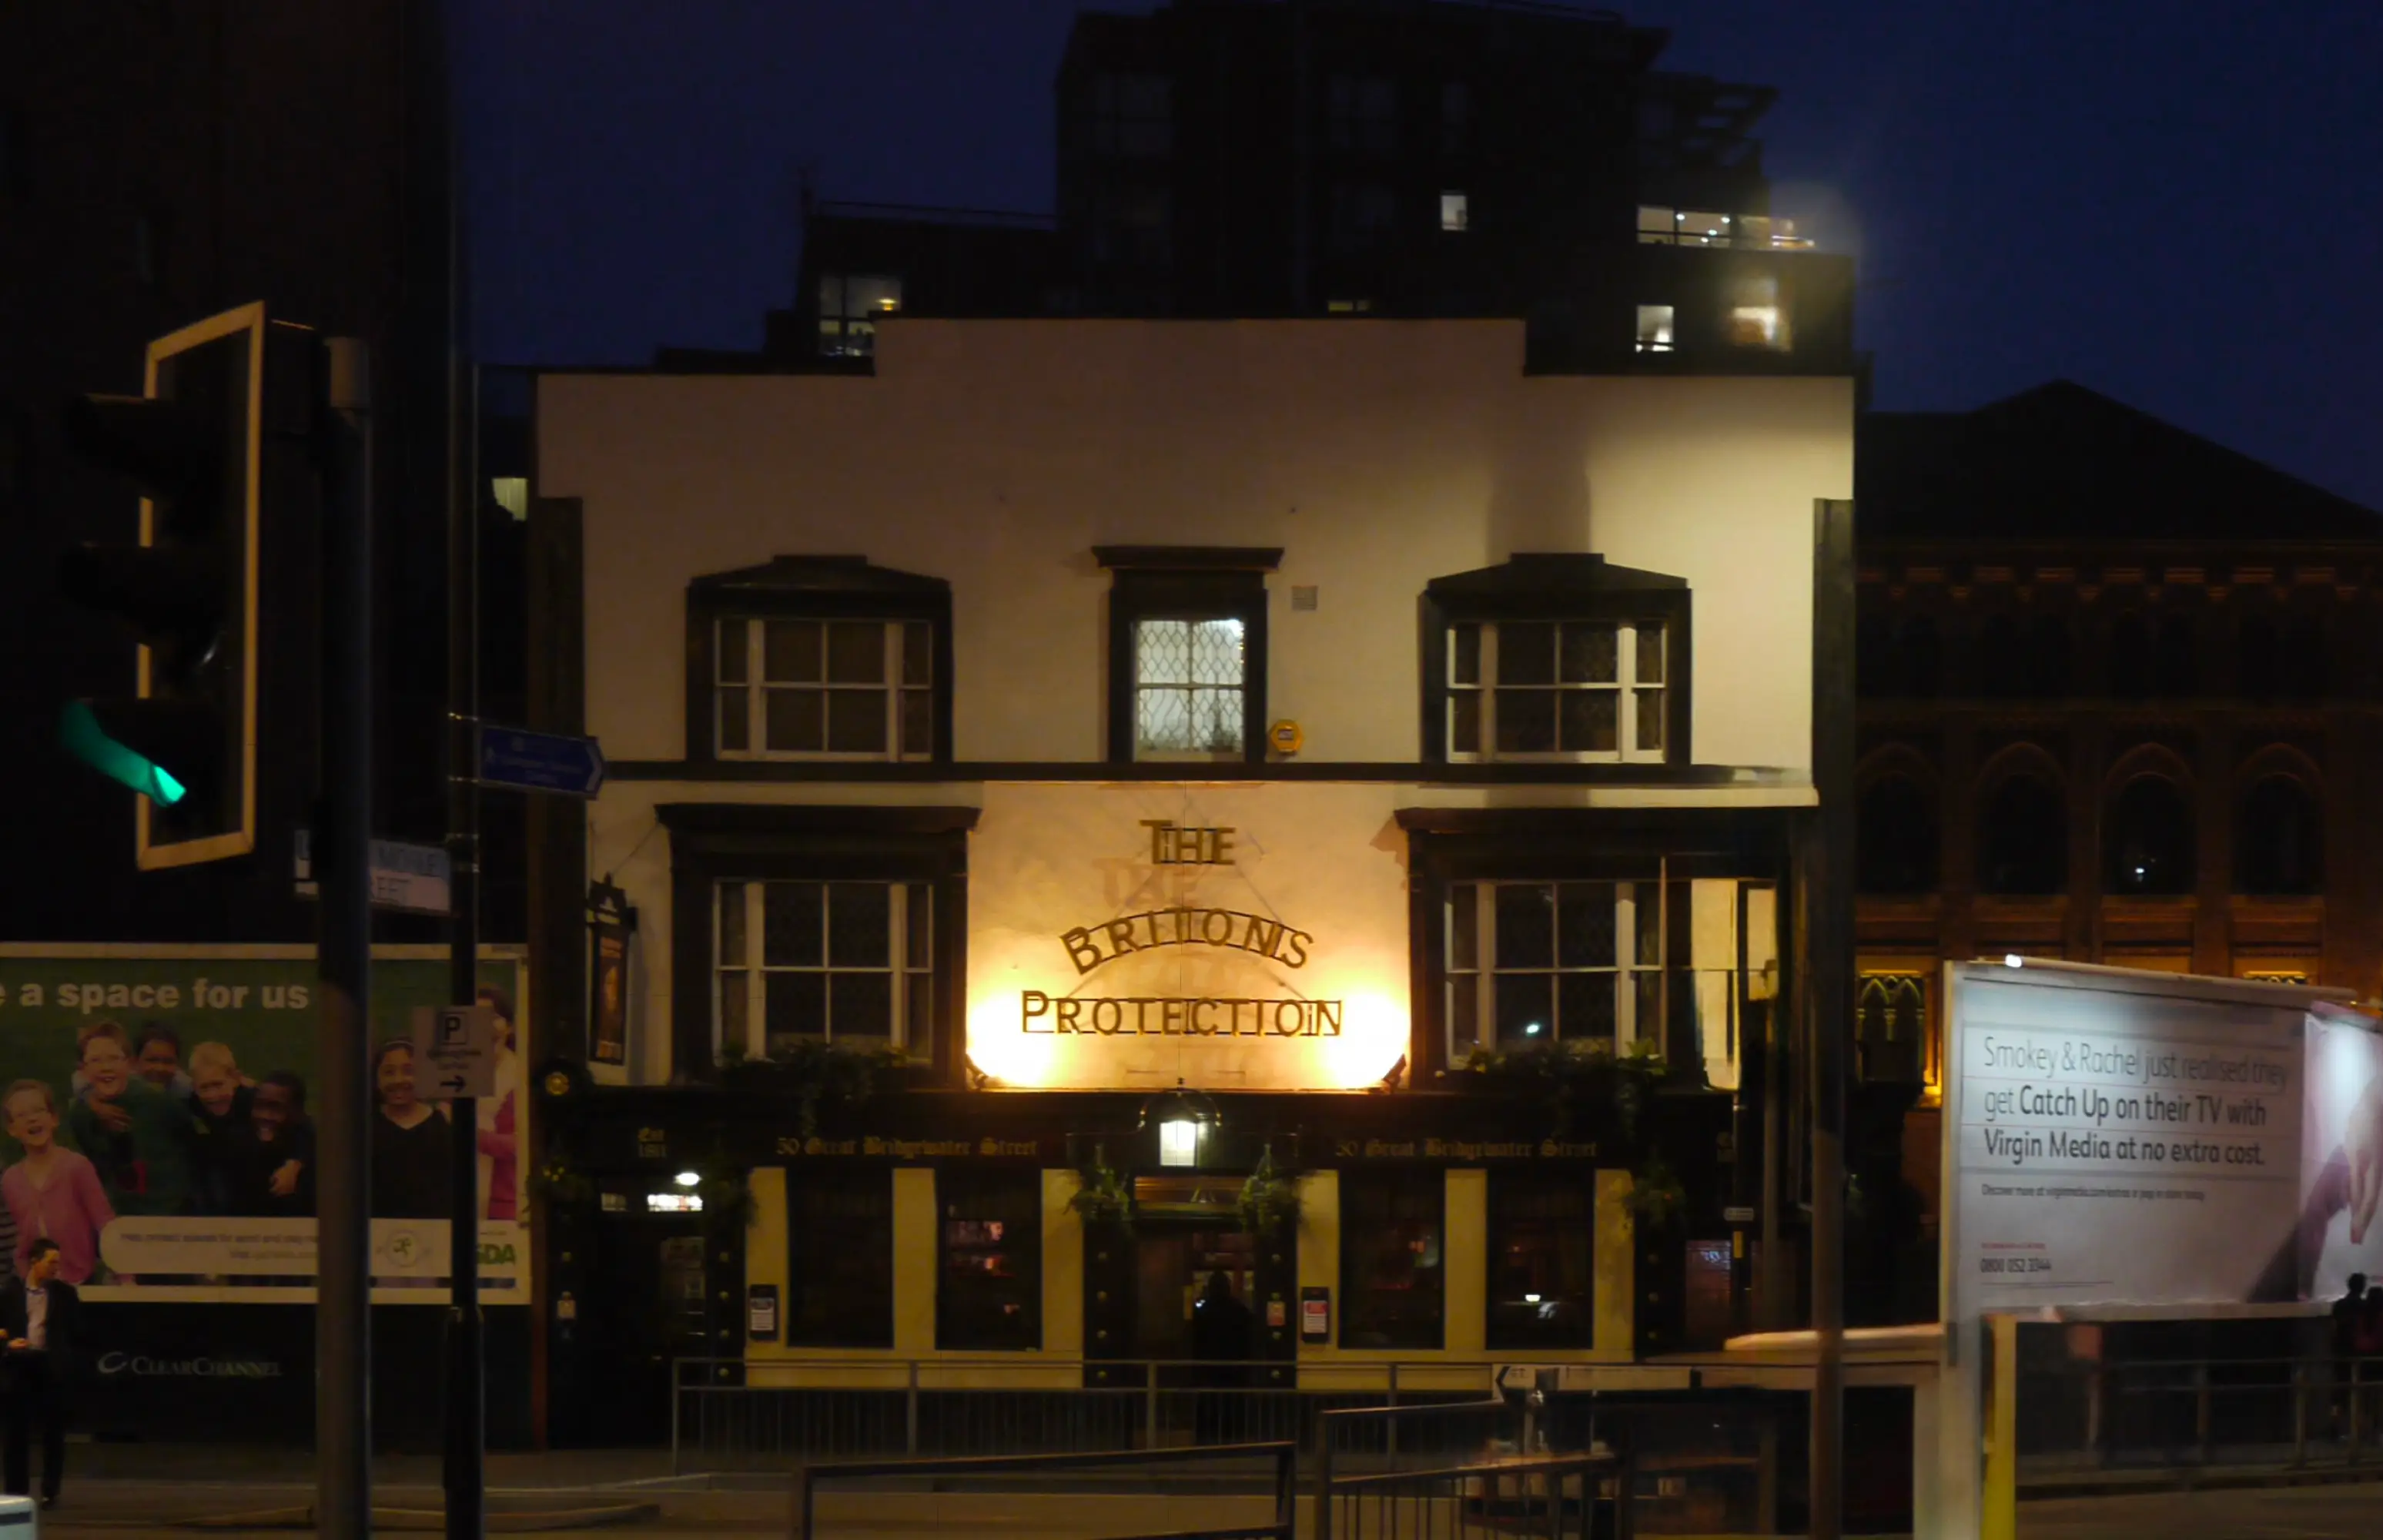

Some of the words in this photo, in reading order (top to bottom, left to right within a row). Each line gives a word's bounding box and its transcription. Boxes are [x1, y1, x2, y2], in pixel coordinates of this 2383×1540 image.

[1140, 820, 1235, 865] THE
[1060, 907, 1312, 975] BRITONS
[19, 983, 44, 1007] a
[56, 983, 180, 1016] space
[192, 978, 249, 1009] for
[261, 985, 310, 1009] us
[1022, 991, 1341, 1036] PROTECTION
[445, 1016, 460, 1040] P
[1984, 1036, 2056, 1078] Smokey
[2063, 1042, 2076, 1071] &
[2081, 1043, 2141, 1076] Rachel
[2143, 1052, 2178, 1084] just
[1984, 1088, 2014, 1121] get
[2020, 1086, 2077, 1116] Catch
[2083, 1089, 2109, 1126] Up
[2117, 1098, 2139, 1120] on
[2146, 1092, 2191, 1123] their
[2196, 1095, 2223, 1124] TV
[2227, 1098, 2266, 1126] with
[1984, 1128, 2042, 1165] Virgin
[2050, 1131, 2110, 1160] Media
[2117, 1137, 2136, 1160] at
[2142, 1143, 2164, 1161] no
[2171, 1143, 2220, 1163] extra
[2224, 1144, 2265, 1165] cost.
